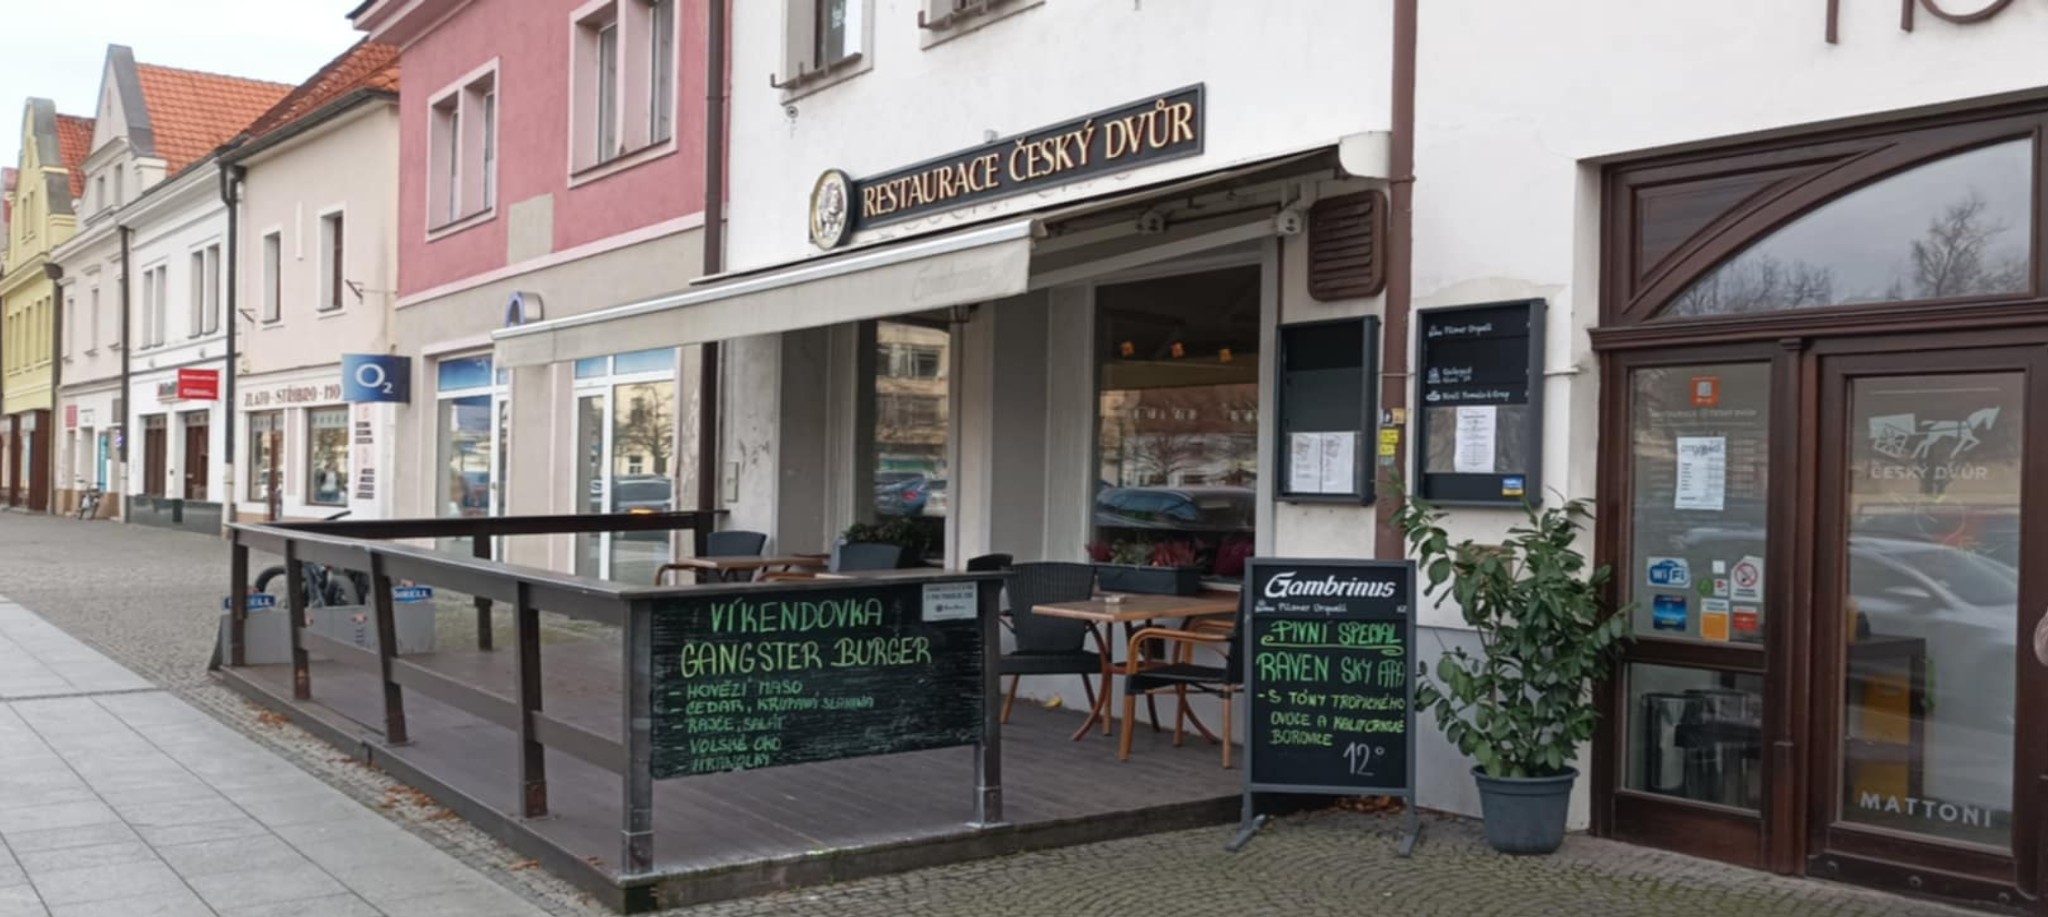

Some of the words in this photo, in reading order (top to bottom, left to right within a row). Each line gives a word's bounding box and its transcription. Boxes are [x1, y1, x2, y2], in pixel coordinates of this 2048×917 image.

[862, 152, 1000, 218] RESTAURACE
[1008, 119, 1096, 183] ČESKÝ
[1104, 97, 1195, 160] DVŮR
[1934, 460, 1988, 480] DVŮR
[1264, 570, 1397, 598] Gambrinus
[710, 597, 882, 633] VÍKENDOVKA
[680, 641, 823, 678] GANGSTER
[829, 636, 932, 668] BURGER
[1255, 652, 1329, 681] RAVEN
[1340, 656, 1373, 684] SKY
[1317, 715, 1327, 727] A
[1860, 790, 1993, 828] MATTONI
